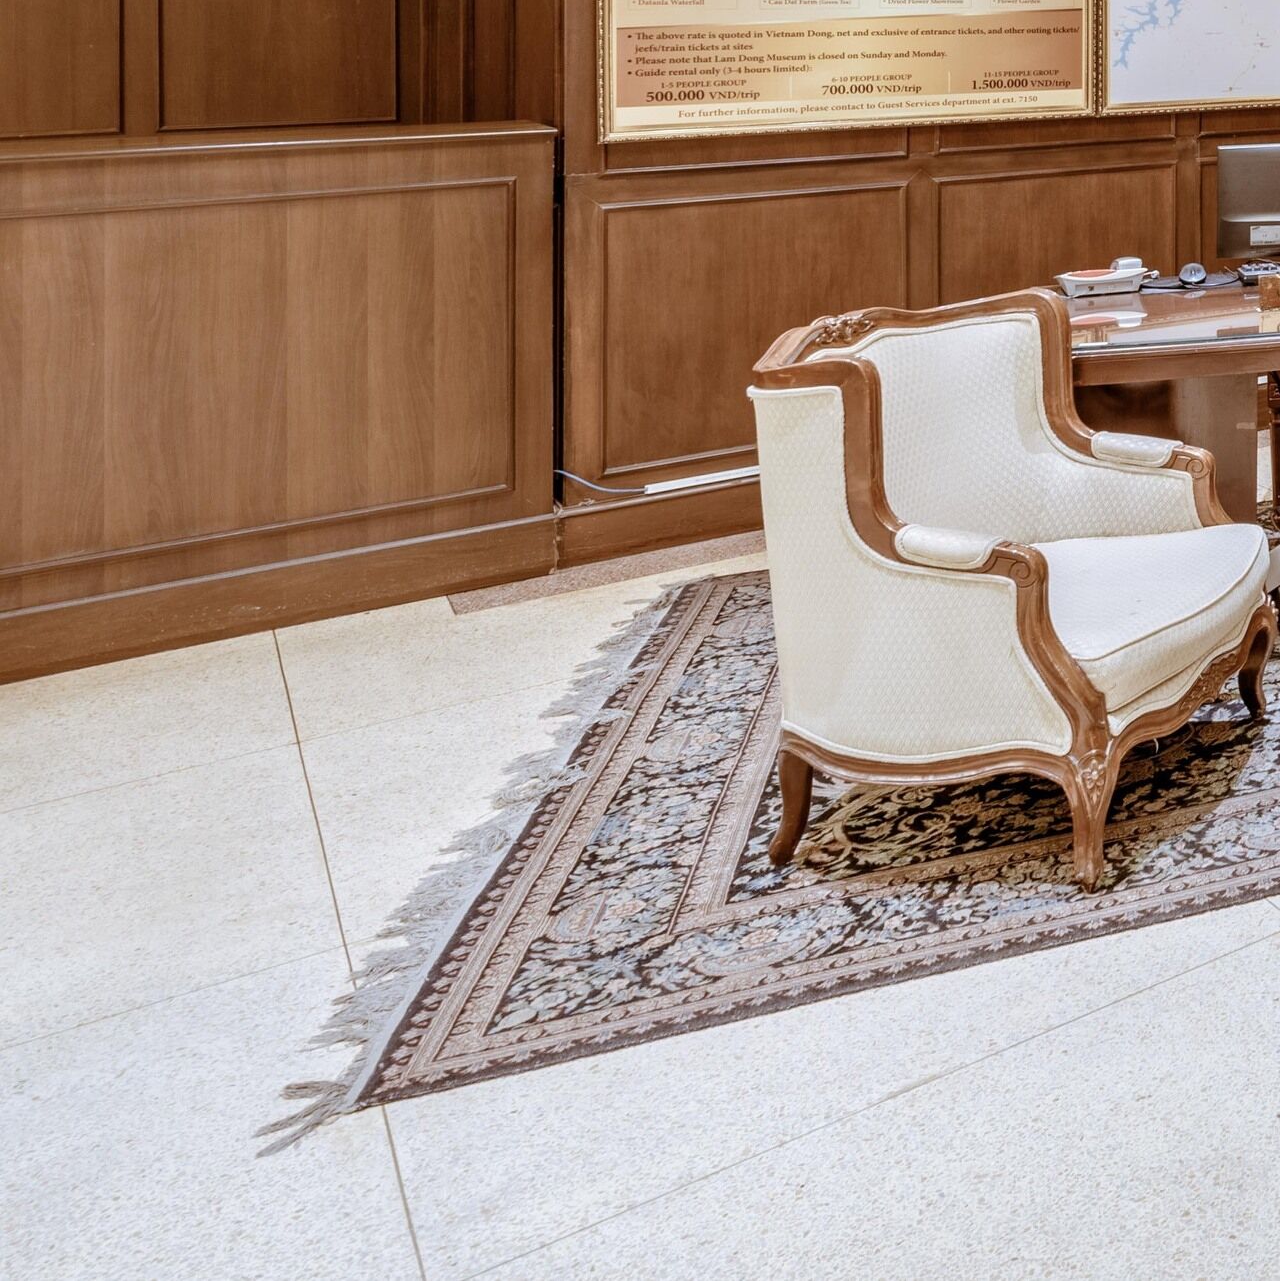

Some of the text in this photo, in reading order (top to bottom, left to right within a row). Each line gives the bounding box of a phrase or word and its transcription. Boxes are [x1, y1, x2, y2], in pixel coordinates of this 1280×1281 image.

[635, 32, 654, 40] The
[718, 31, 751, 40] quoted
[808, 30, 834, 38] Dong,
[739, 55, 764, 63] Dong
[861, 52, 892, 60] Sunday
[669, 68, 697, 76] rental
[699, 67, 720, 76] only
[723, 67, 742, 75] (3-4
[984, 71, 1002, 79] 11-15
[1003, 70, 1030, 78] PEOPLE
[822, 84, 922, 94] 700.000 VND/trip
[973, 79, 1070, 89] 1.500.000 VND/trip
[647, 90, 760, 102] 500.000 VND/trip
[699, 109, 734, 117] further
[737, 107, 798, 115] information,
[800, 105, 828, 114] please
[942, 98, 990, 107] department
